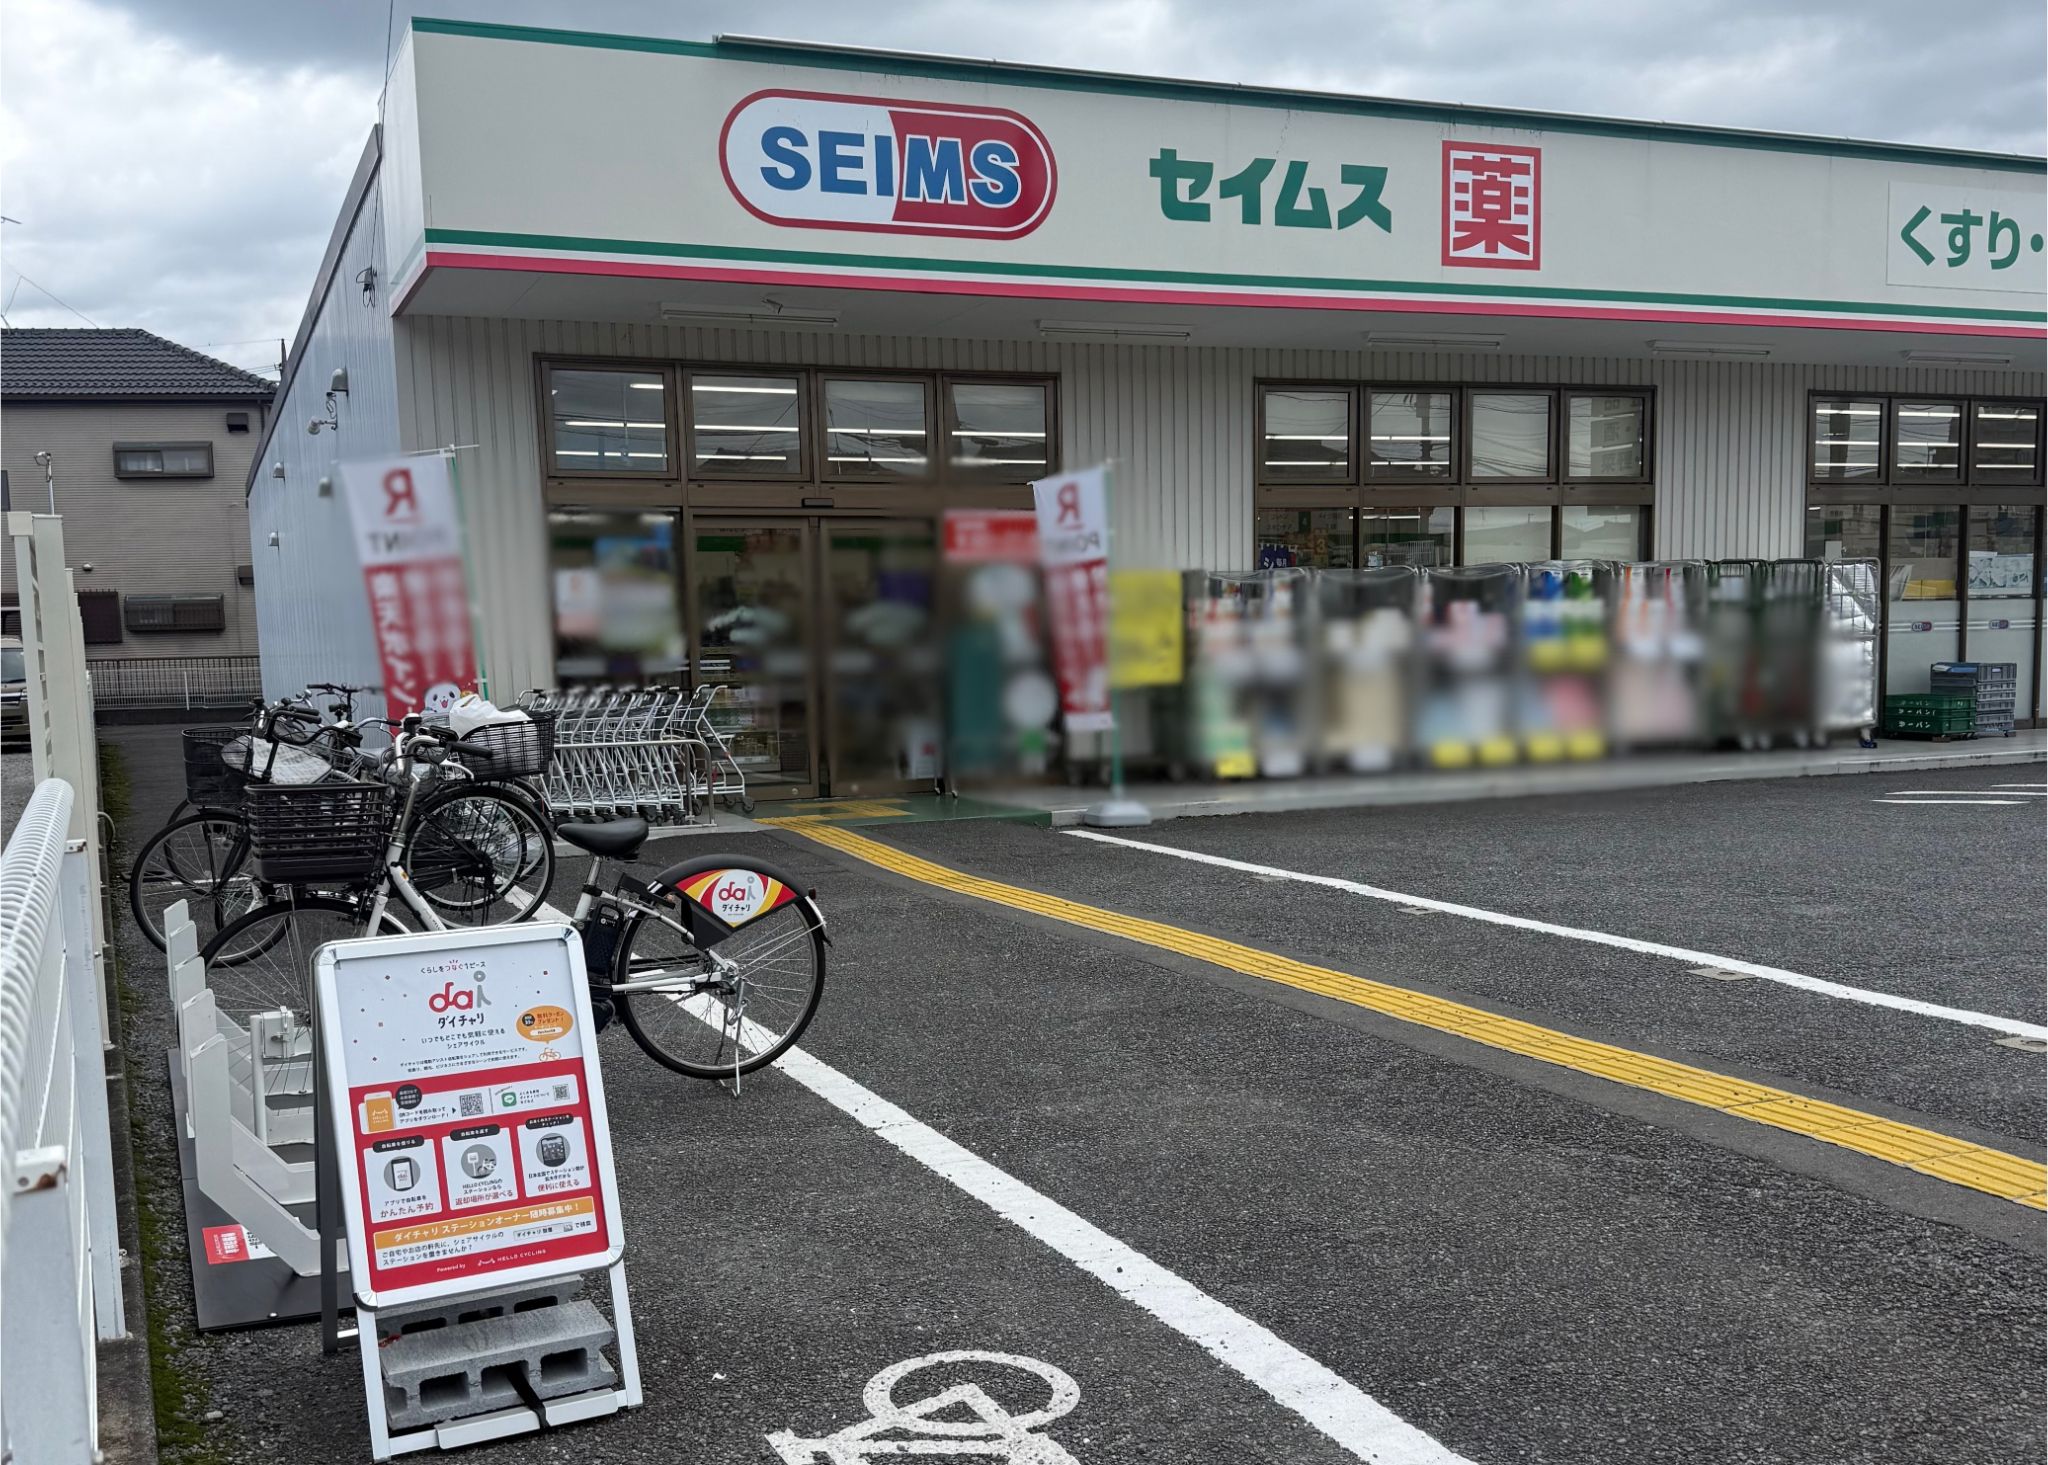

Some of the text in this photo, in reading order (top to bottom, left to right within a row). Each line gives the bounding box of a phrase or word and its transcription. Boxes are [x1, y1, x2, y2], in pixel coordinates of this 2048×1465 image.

[760, 125, 1021, 209] SEIMS
[1149, 147, 1392, 233] セイムス
[1452, 155, 1531, 256] 薬
[718, 876, 756, 901] dai
[722, 903, 751, 912] ダイチャリ
[429, 970, 492, 1013] dai
[437, 1013, 485, 1029] ダイチャリ
[447, 1040, 486, 1050] シェアサイクル
[537, 1179, 580, 1192] 便利に使える
[384, 1195, 427, 1206] アプリで自転車を
[455, 1189, 513, 1206] 返却場所が選べる
[380, 1202, 434, 1218] かんたん予約
[395, 1228, 439, 1242] ダイチャリ
[436, 1264, 459, 1273] Powered
[497, 1254, 518, 1262] HELLO
[520, 1249, 547, 1258] CYCLING
